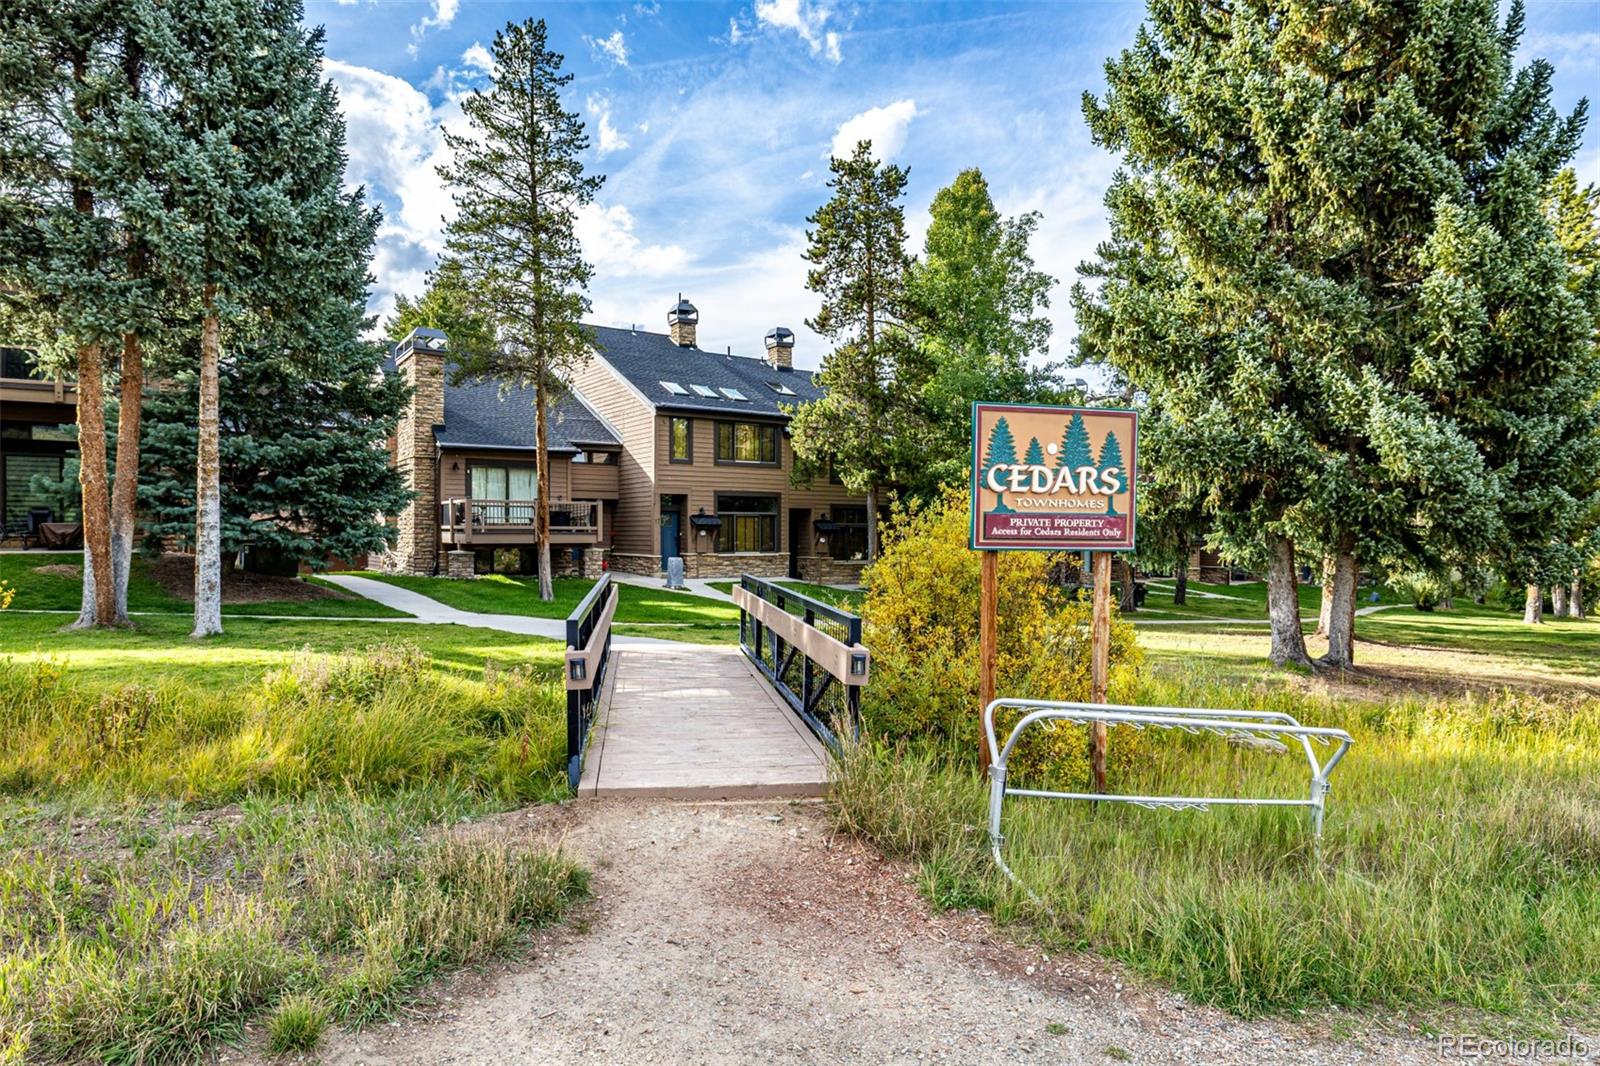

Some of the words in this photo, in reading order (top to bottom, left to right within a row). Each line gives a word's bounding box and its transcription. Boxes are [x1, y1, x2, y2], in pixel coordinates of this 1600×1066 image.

[987, 463, 1121, 495] CEDARS
[1015, 497, 1105, 509] TOWNHOMES
[1009, 518, 1051, 527] PRIVATE
[1054, 518, 1105, 528] PROPERTY
[991, 527, 1018, 536] Access
[1020, 527, 1032, 536] for
[1034, 527, 1061, 536] Cedars
[1063, 528, 1100, 537] Residents
[1102, 528, 1121, 538] Only
